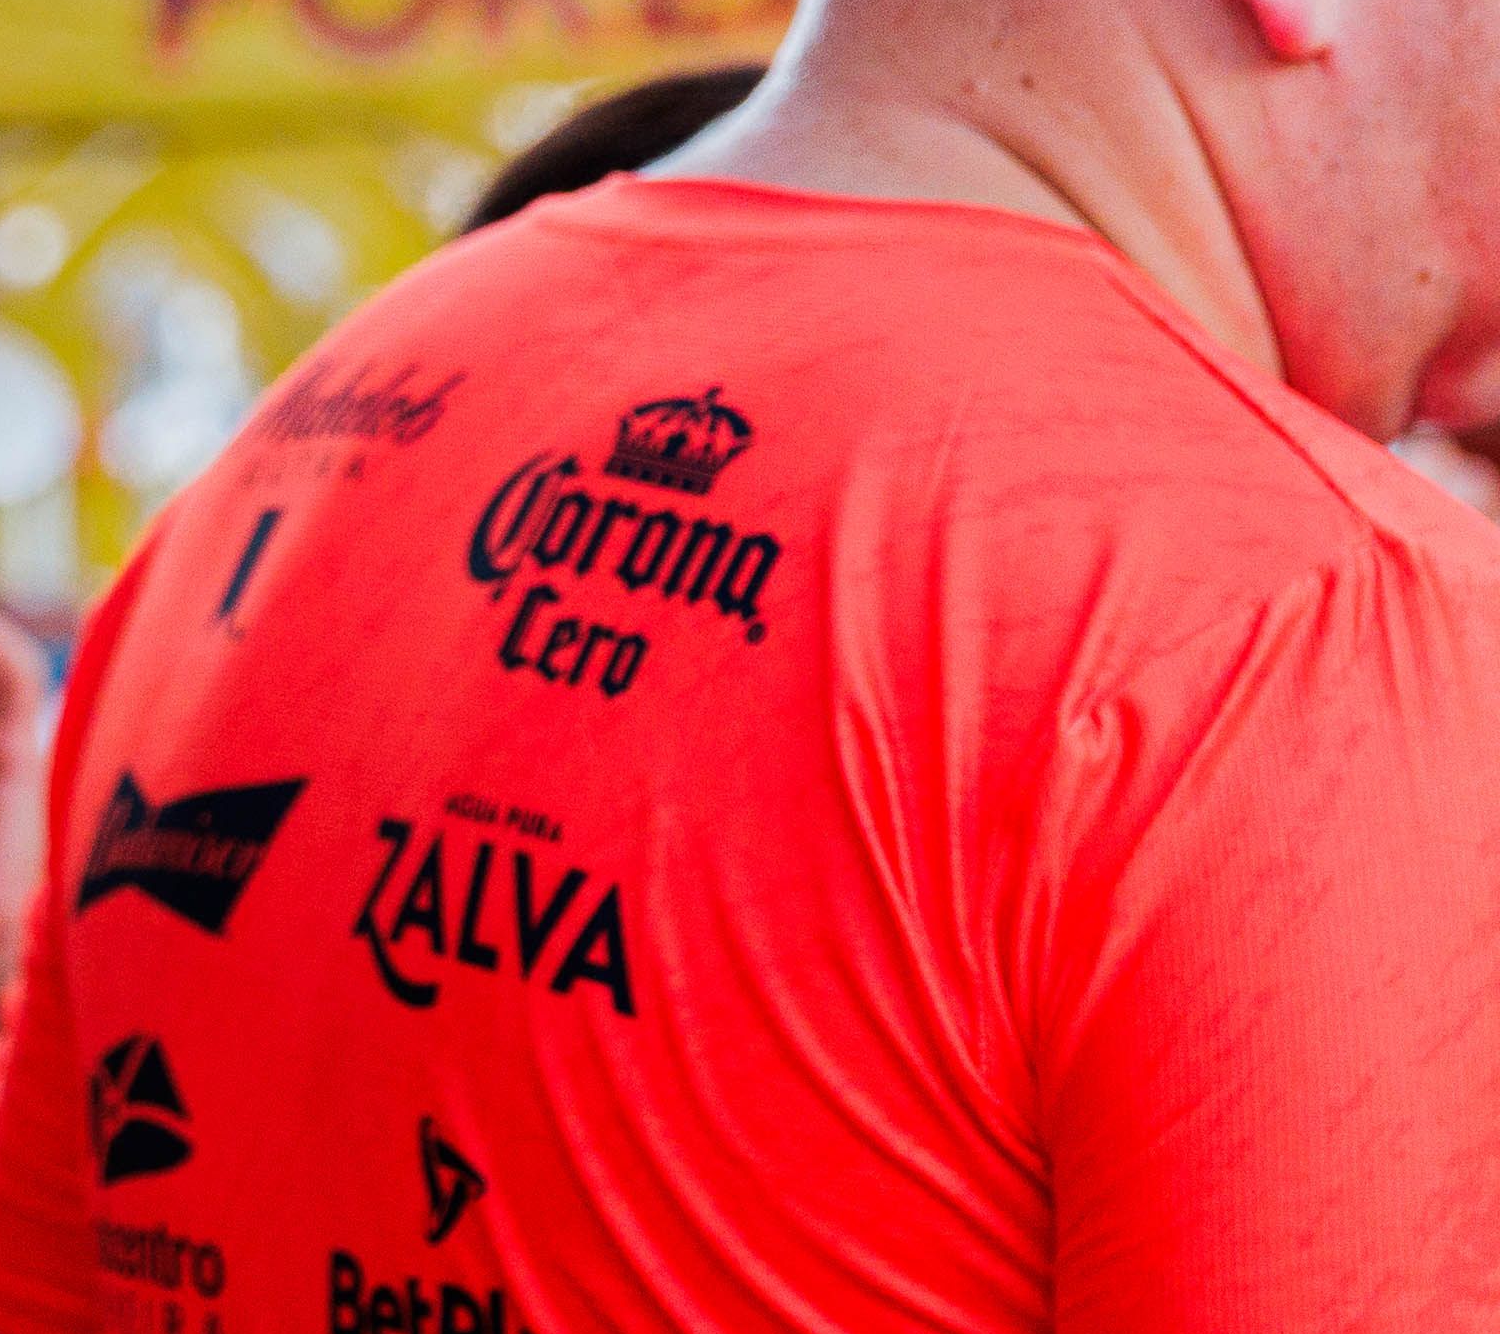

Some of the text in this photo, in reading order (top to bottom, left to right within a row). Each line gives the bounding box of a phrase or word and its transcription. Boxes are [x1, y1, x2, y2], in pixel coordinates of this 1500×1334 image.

[466, 453, 781, 622] Corona
[500, 584, 649, 698] Cero
[352, 816, 637, 1019] ZALVA
